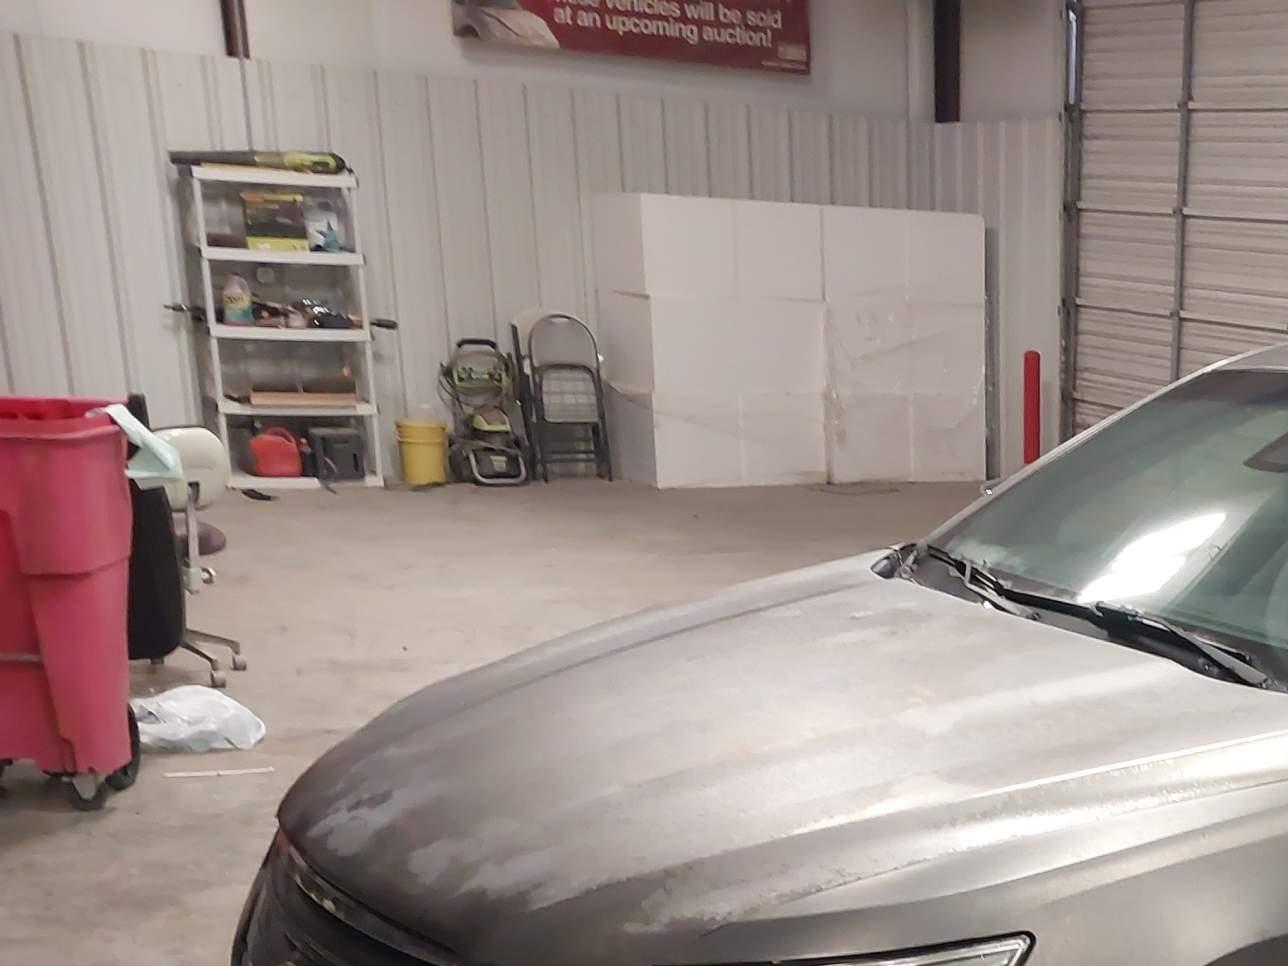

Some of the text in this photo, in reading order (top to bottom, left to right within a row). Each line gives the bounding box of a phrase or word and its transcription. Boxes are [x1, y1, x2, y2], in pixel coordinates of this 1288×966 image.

[553, 5, 773, 47] at an upcoming auction!
[684, 1, 715, 21] will
[718, 4, 742, 24] be
[746, 9, 783, 29] sold
